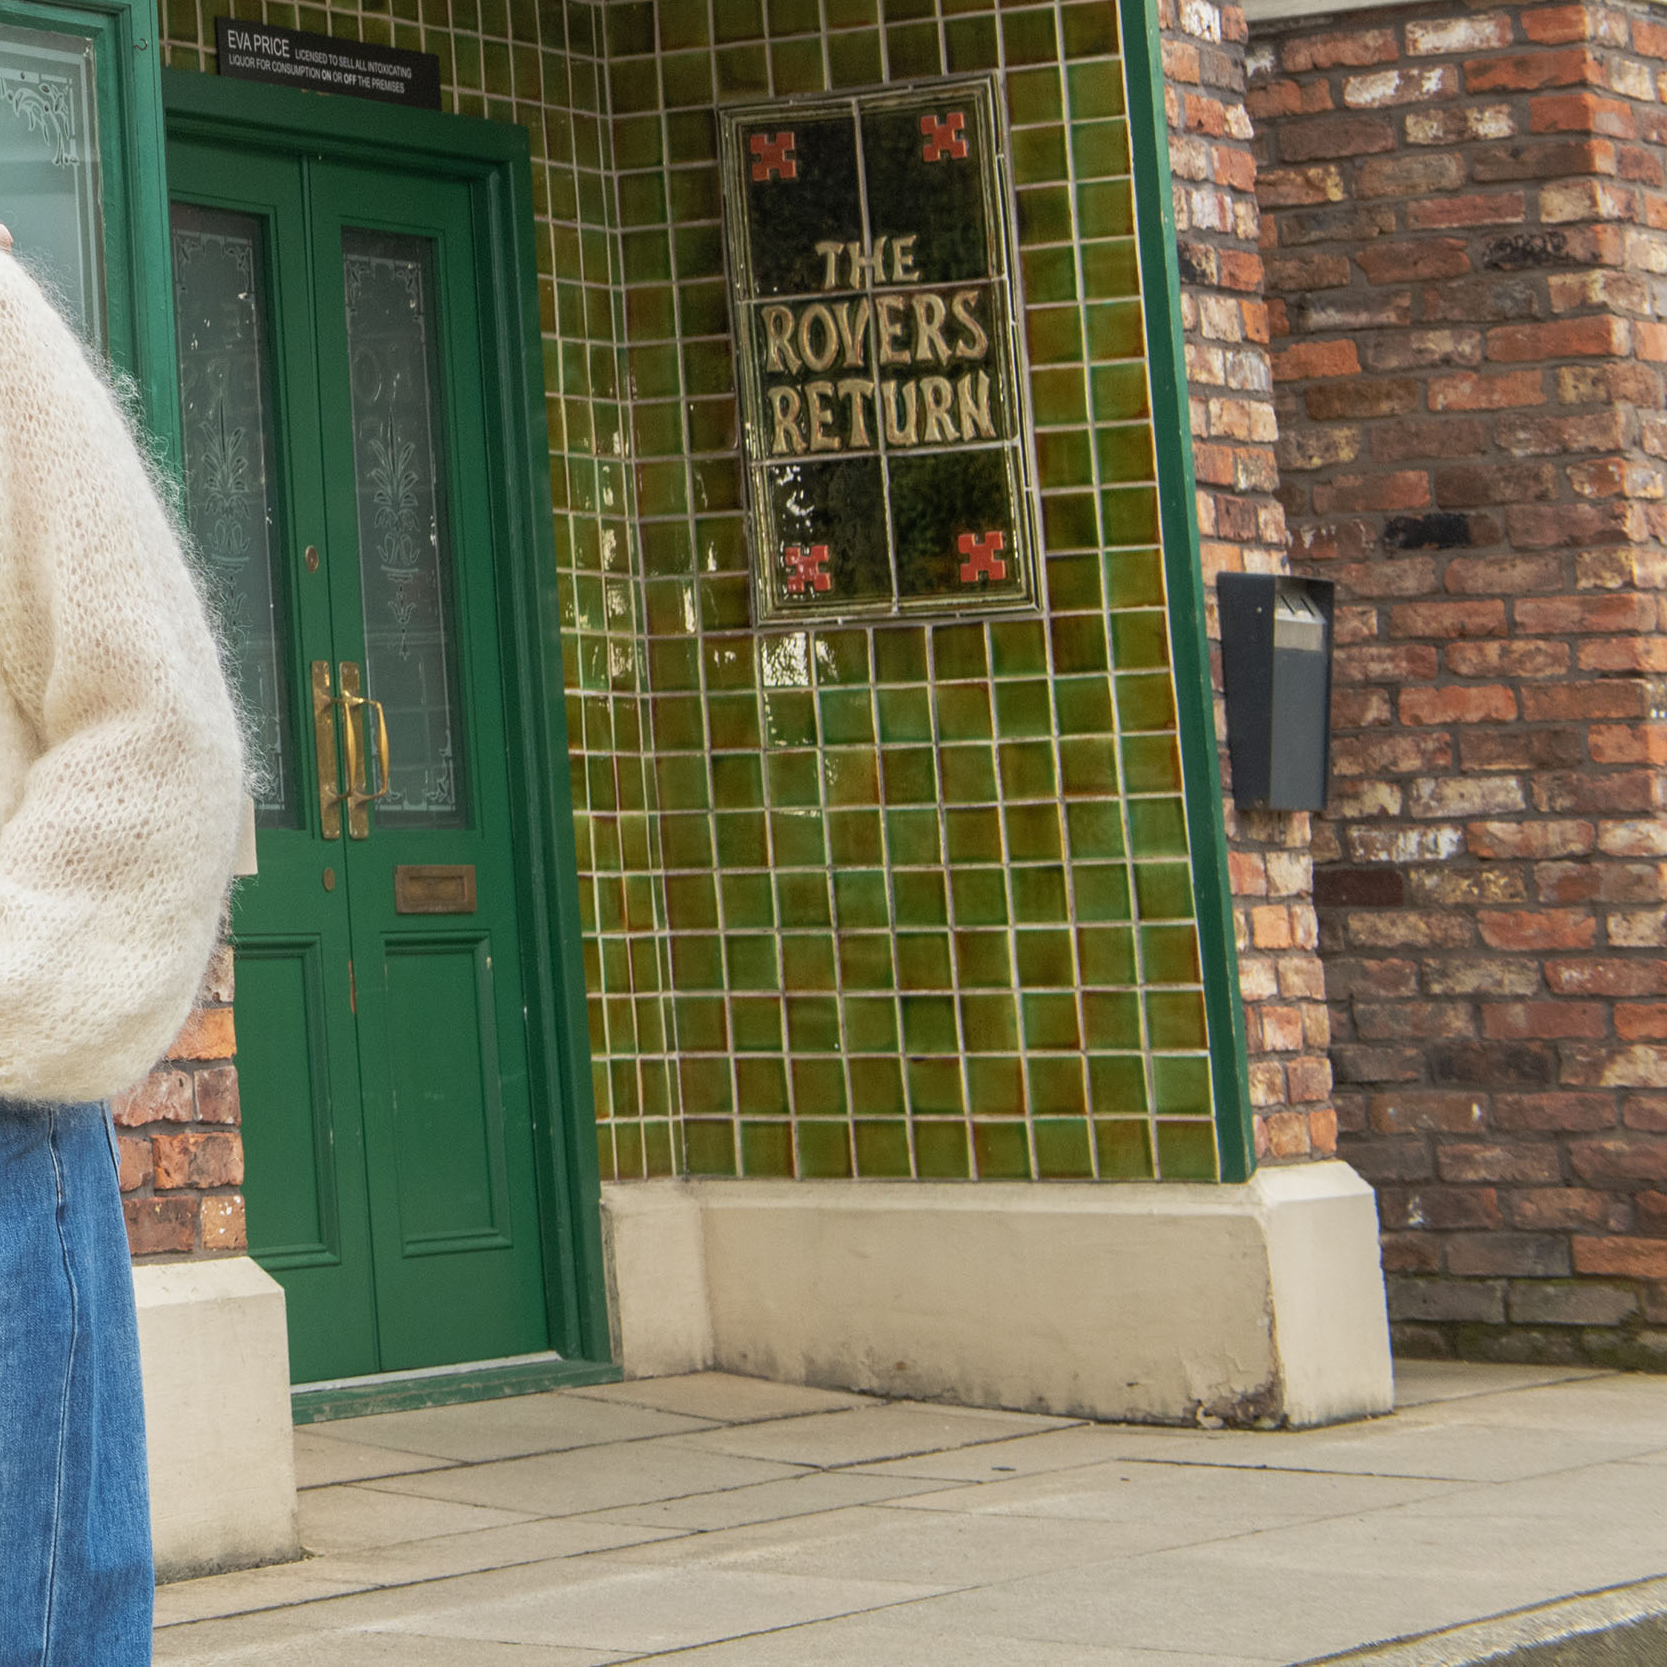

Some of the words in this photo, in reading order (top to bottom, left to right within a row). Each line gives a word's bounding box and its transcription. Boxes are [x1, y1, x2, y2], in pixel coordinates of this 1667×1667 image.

[227, 29, 252, 52] EVA
[253, 34, 291, 58] PRICE
[294, 48, 328, 64] LICENSED
[328, 54, 338, 66] TO
[338, 55, 355, 69] SELL
[355, 58, 367, 71] ALL
[367, 60, 412, 79] INTOXICATING
[228, 53, 256, 69] LIQUOR
[256, 57, 271, 71] FOR
[271, 61, 321, 80] CONSUMPTION
[321, 69, 332, 81] ON
[332, 70, 343, 83] OR
[343, 73, 357, 86] OFF
[357, 75, 371, 89] THE
[371, 77, 405, 94] PREMISES
[815, 235, 921, 290] THE
[761, 289, 989, 375] ROVERS
[768, 369, 997, 456] RETURN
